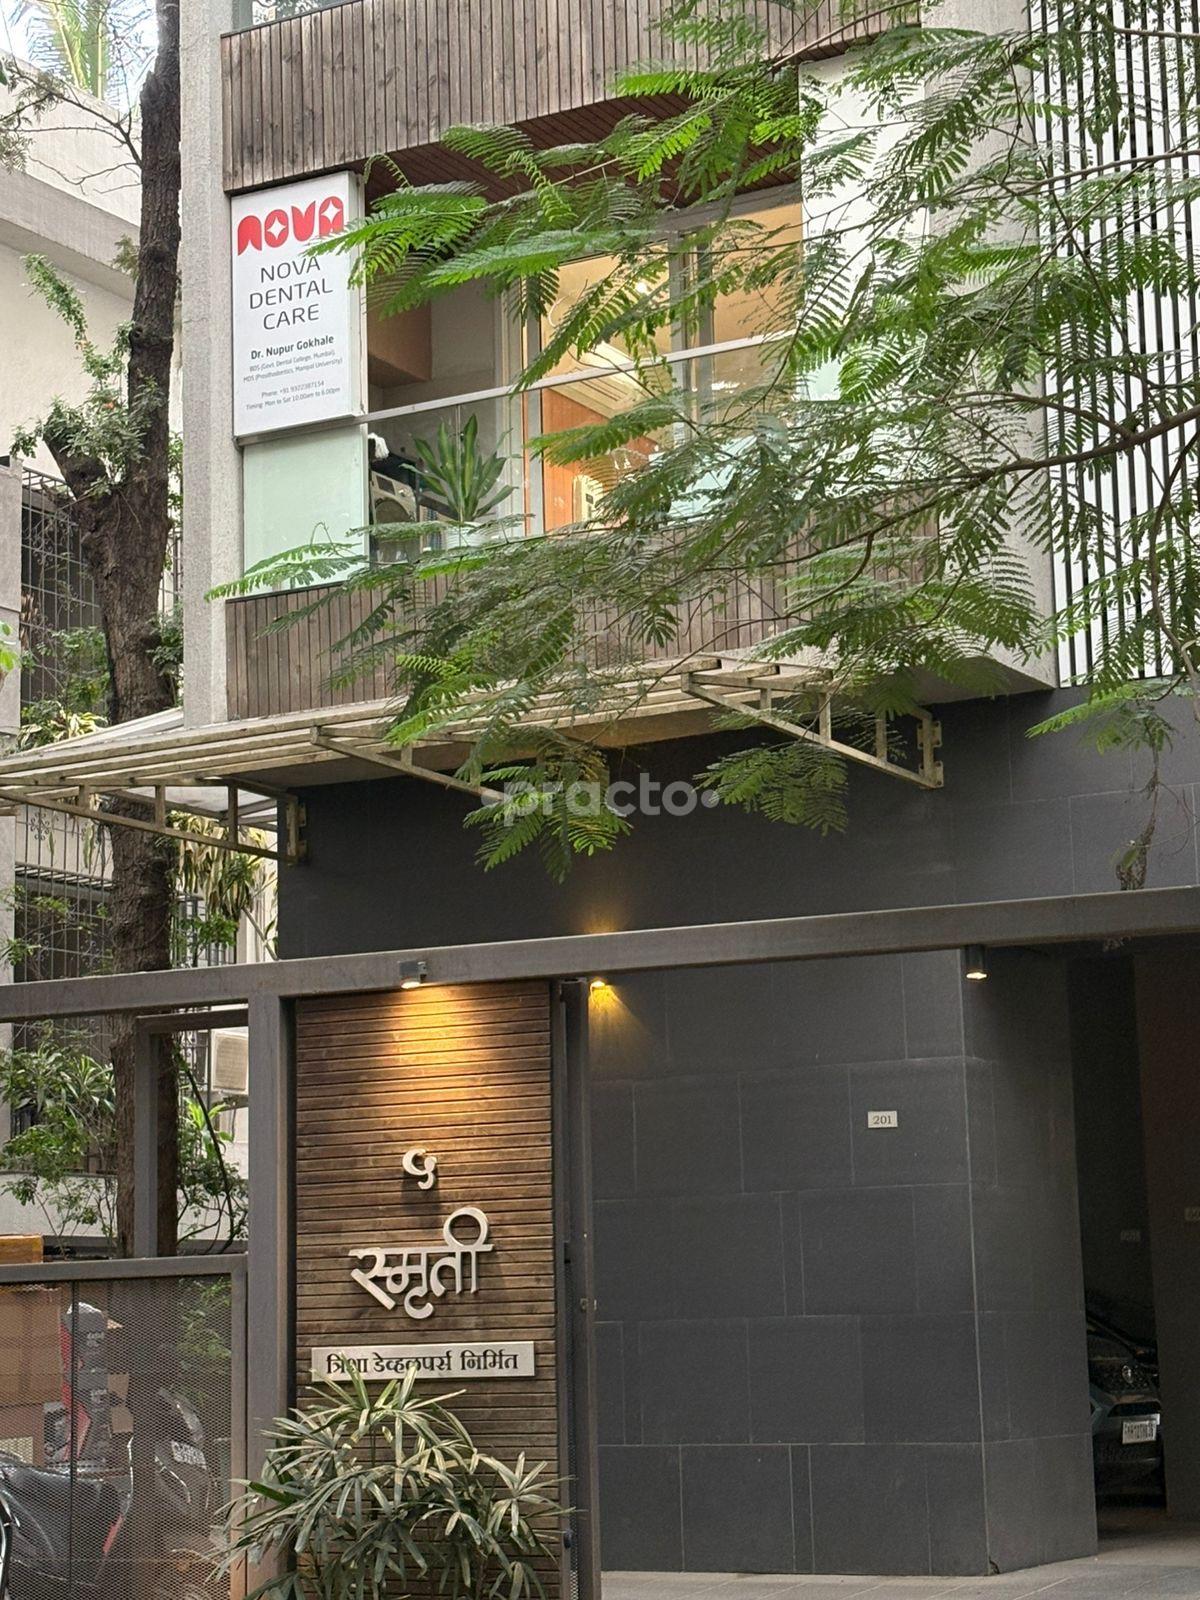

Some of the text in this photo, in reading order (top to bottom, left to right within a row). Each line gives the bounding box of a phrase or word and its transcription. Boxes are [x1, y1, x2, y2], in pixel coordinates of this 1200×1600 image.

[261, 256, 320, 283] NOVA
[249, 278, 333, 310] DENTAL
[263, 303, 320, 330] CARE
[251, 335, 334, 360] Dr. Nupur Gokhale
[872, 1115, 892, 1125] 201
[348, 1207, 495, 1319] स्मृती
[460, 1349, 519, 1370] निर्मित
